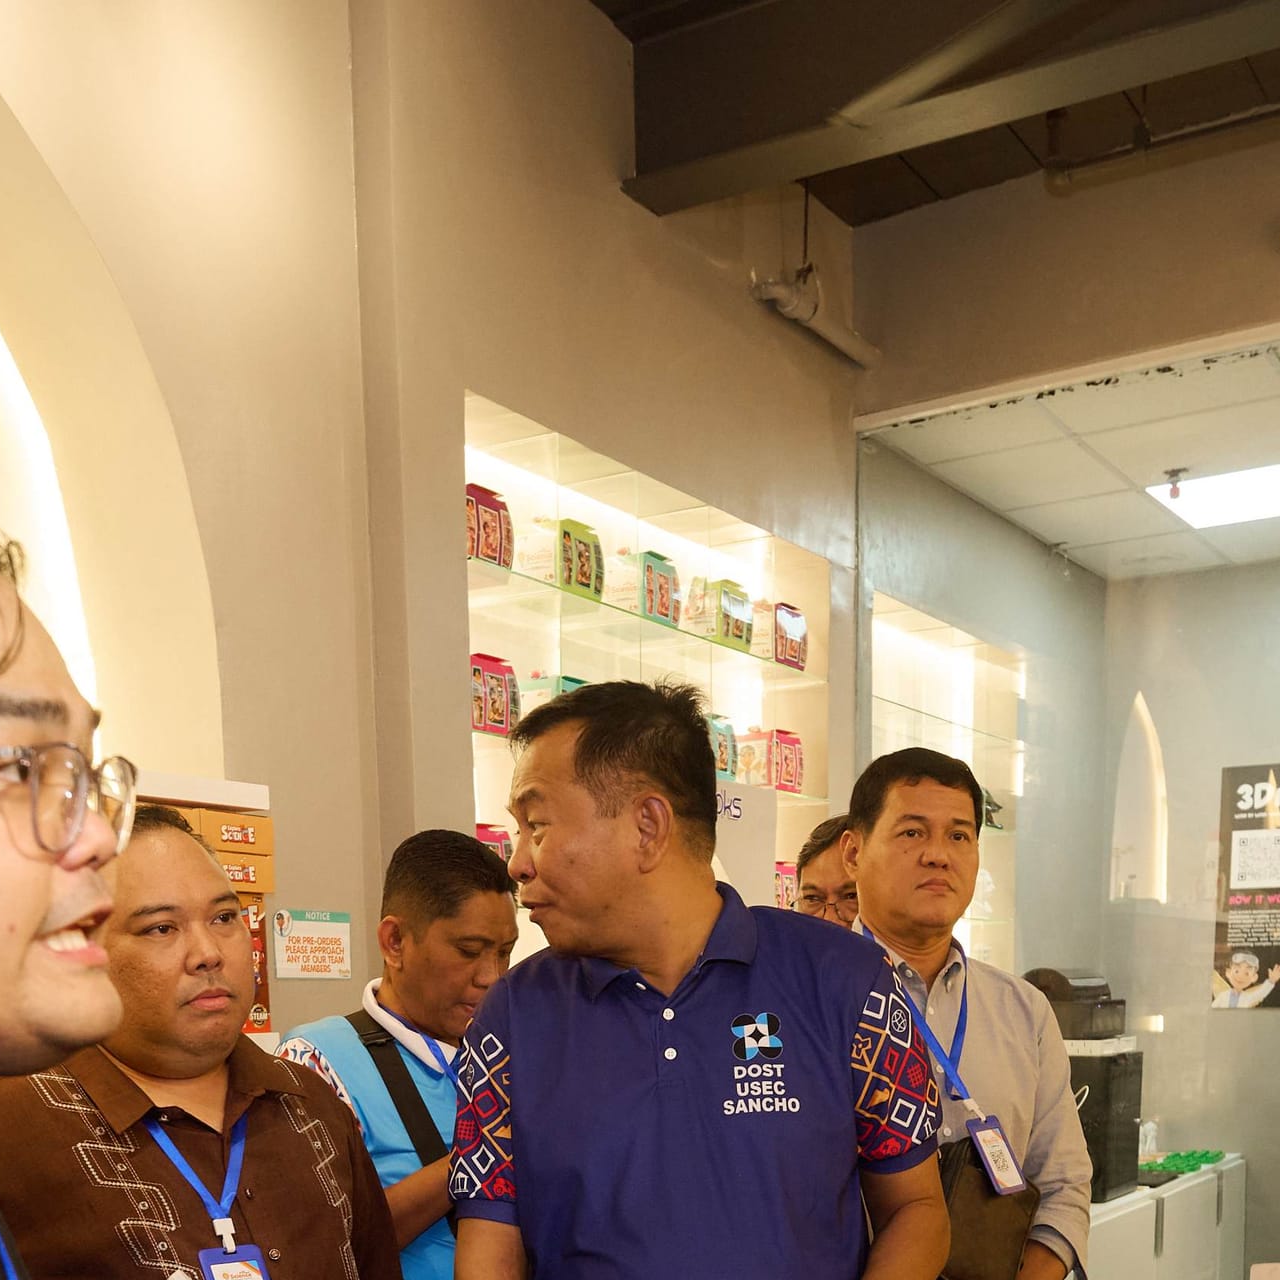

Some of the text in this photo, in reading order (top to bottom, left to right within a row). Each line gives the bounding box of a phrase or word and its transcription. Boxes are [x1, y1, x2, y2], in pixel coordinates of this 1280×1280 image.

[305, 912, 330, 920] NOTICE
[288, 936, 341, 945] FOR PRE-ORDERS
[286, 946, 344, 954] PLEASE APPROACH
[287, 955, 300, 963] ANY
[328, 956, 344, 964] TEAM
[734, 1064, 784, 1079] DOST
[736, 1081, 786, 1096] USEC
[723, 1098, 800, 1115] SANCHO
